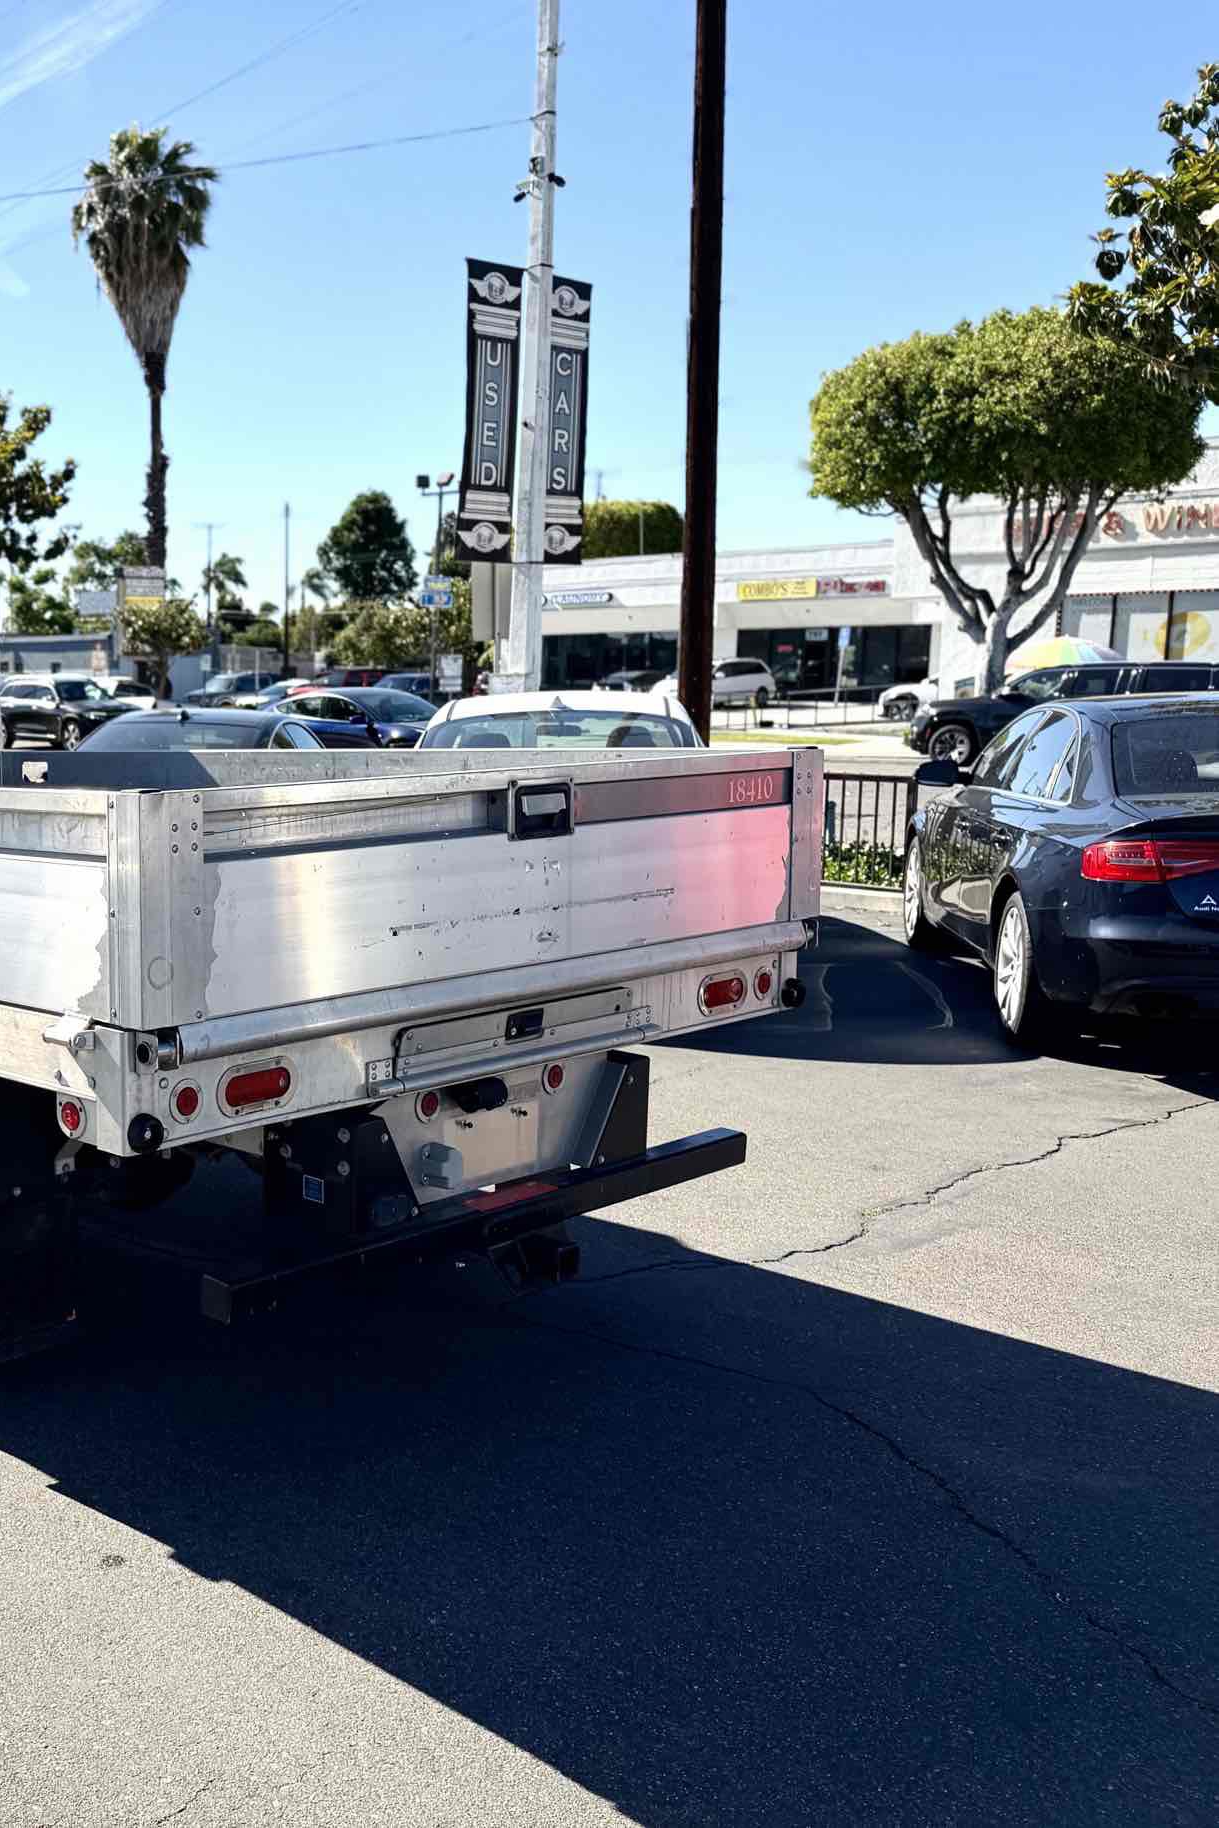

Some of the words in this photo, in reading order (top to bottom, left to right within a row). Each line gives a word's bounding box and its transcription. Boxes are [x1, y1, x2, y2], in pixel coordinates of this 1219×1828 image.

[480, 340, 502, 486] USED
[551, 352, 572, 491] CARS
[1142, 502, 1219, 531] WIN
[727, 775, 774, 803] 18410
